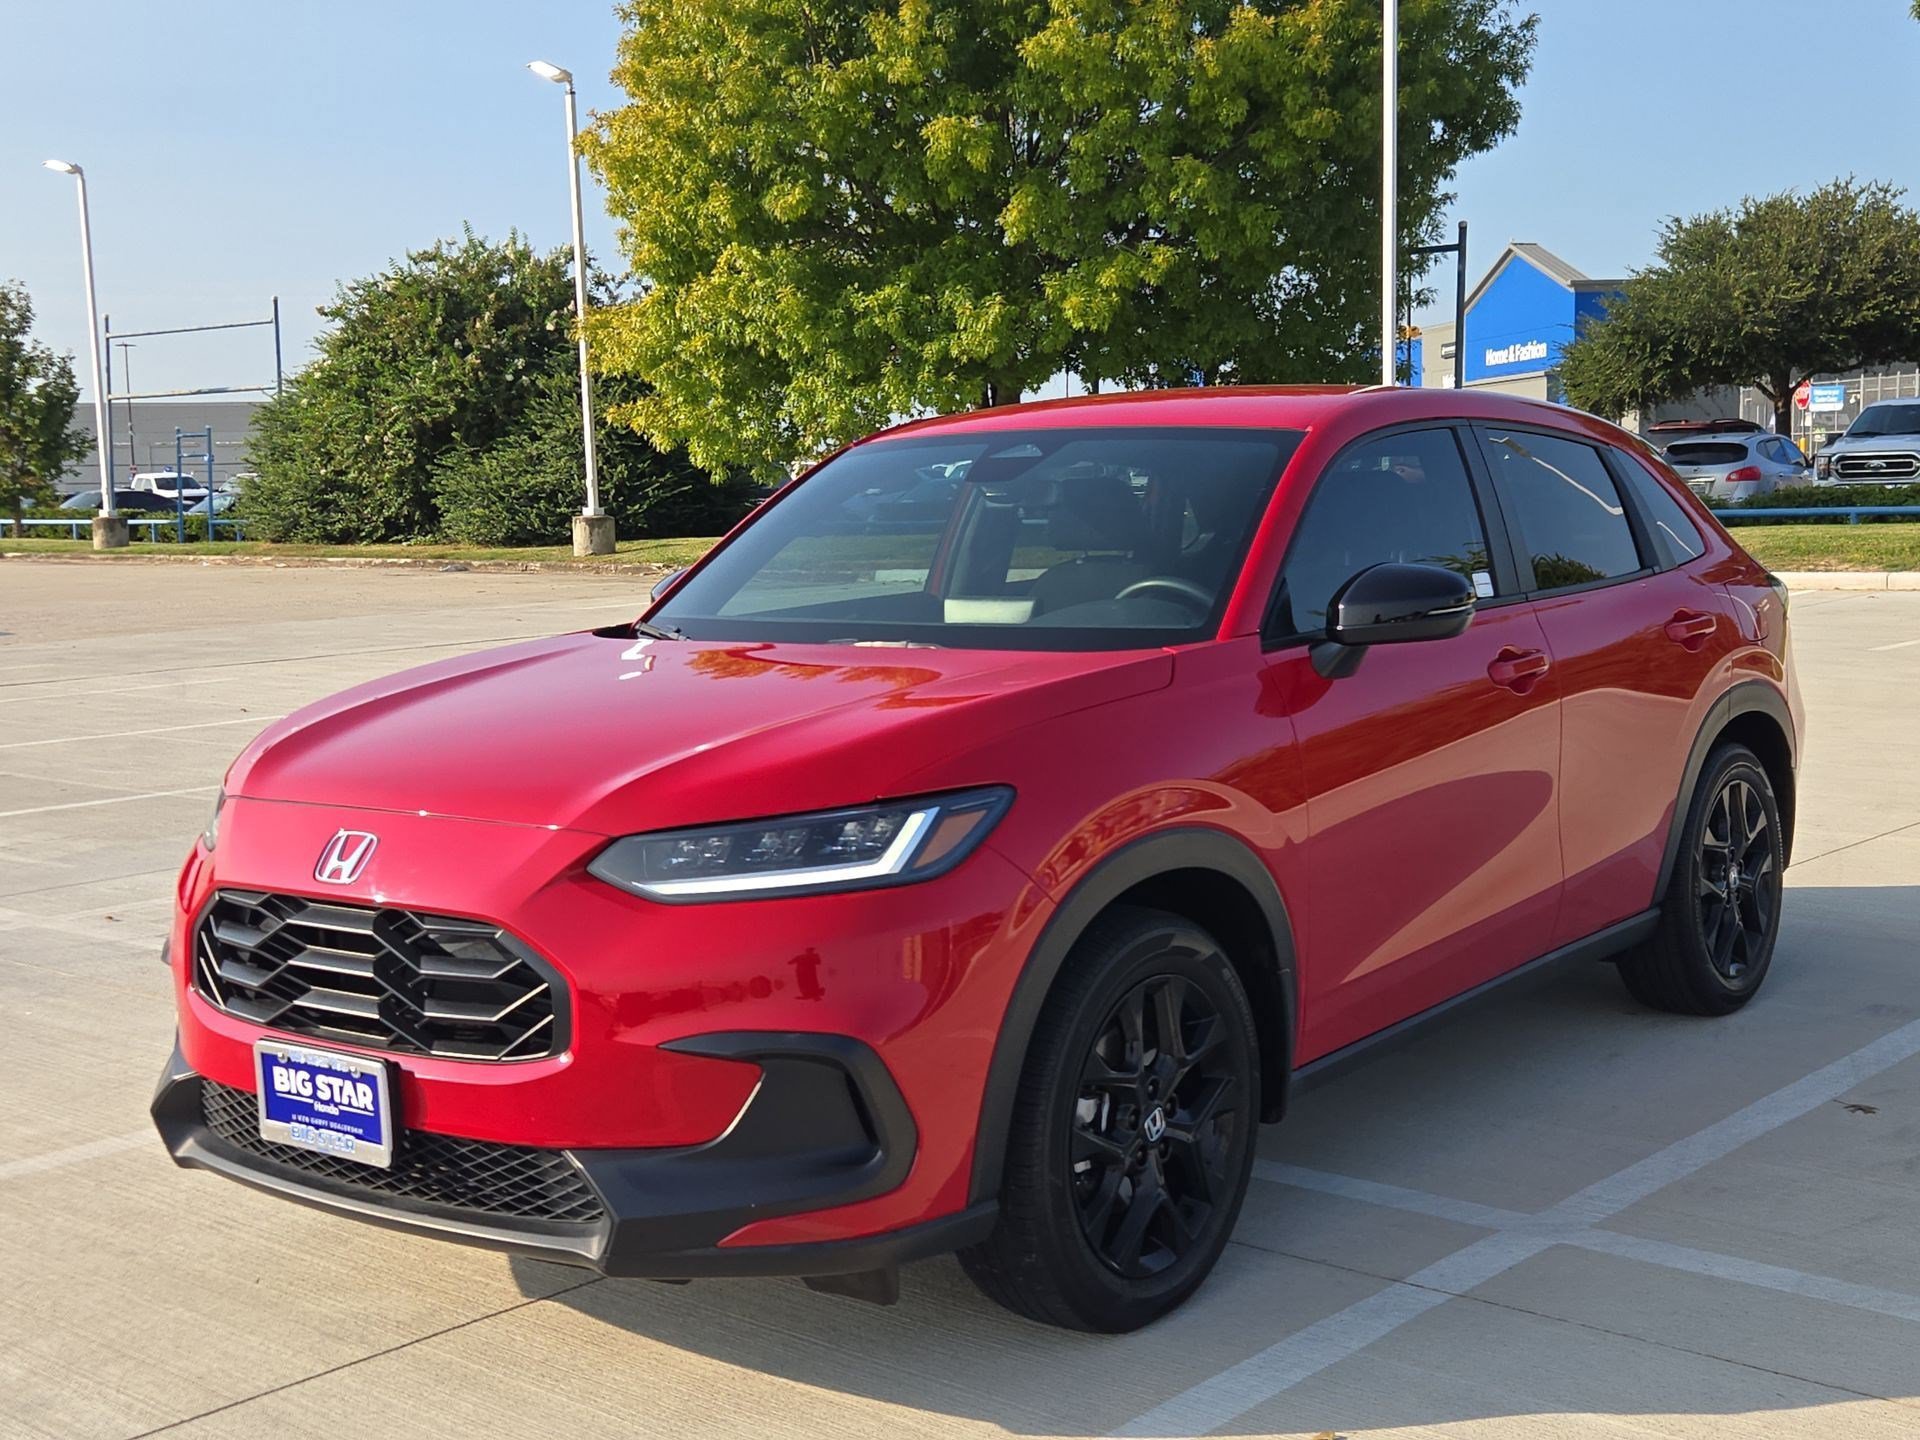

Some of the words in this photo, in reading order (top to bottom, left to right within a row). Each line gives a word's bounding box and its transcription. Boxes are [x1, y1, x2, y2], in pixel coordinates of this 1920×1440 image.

[1485, 348, 1508, 366] Home
[1508, 345, 1515, 363] &
[1515, 340, 1547, 361] Fashion
[272, 1066, 313, 1097] BIG
[315, 1074, 374, 1111] STAR
[291, 1124, 315, 1142] BIG
[317, 1130, 355, 1152] STAR
